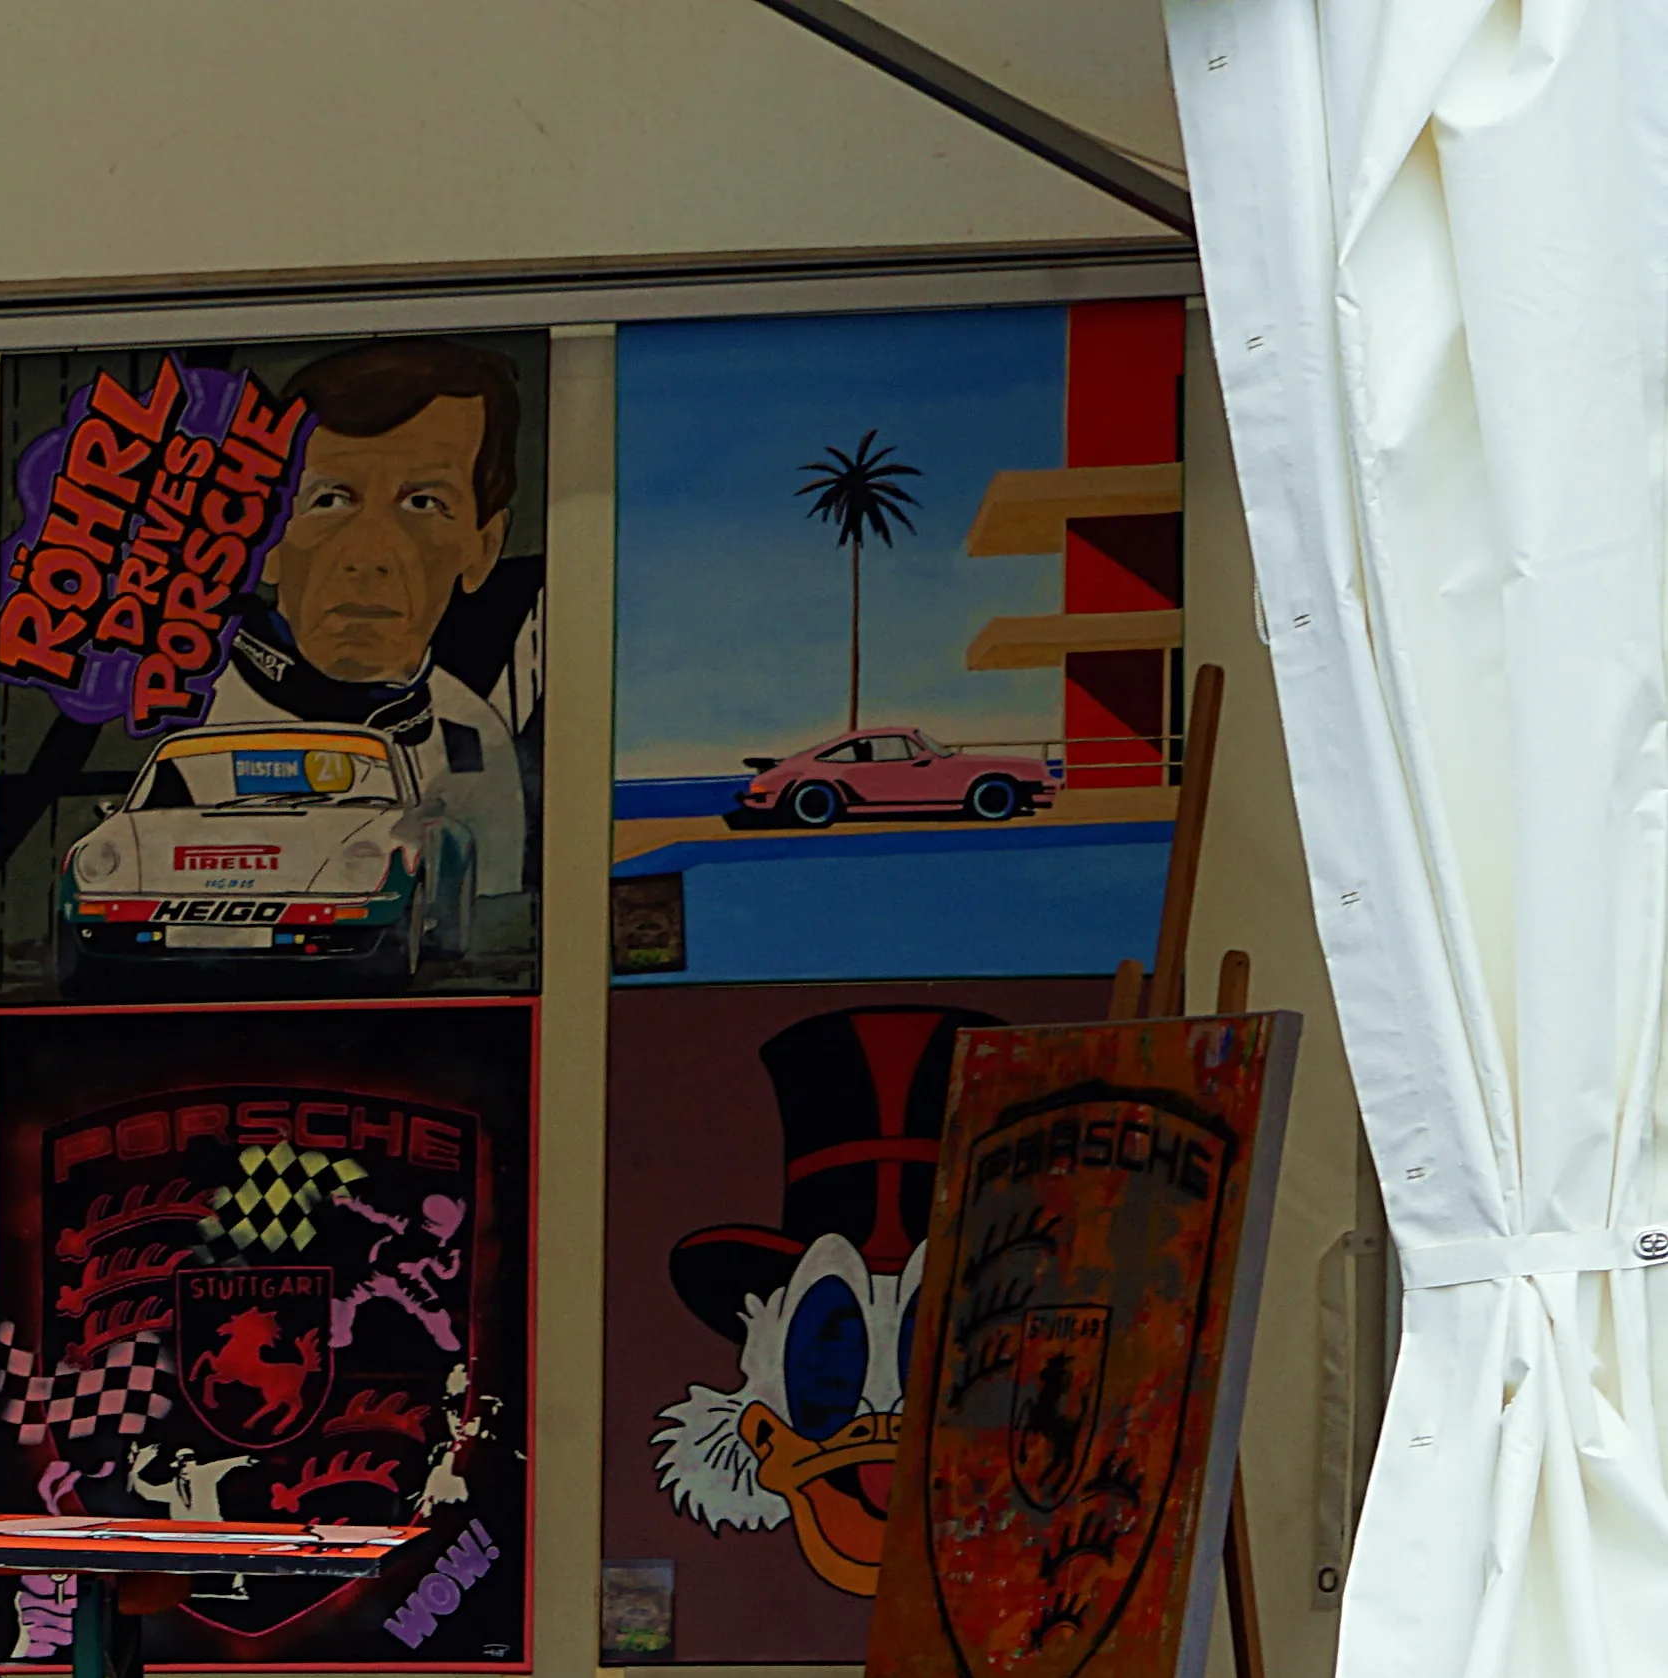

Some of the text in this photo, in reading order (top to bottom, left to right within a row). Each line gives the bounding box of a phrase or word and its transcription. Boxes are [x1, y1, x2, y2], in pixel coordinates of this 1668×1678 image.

[95, 434, 215, 647] DRIVES
[133, 379, 307, 721] PORSCHE
[174, 846, 281, 870] PIRELLI
[153, 902, 287, 922] HEIGO
[55, 1100, 462, 1183] PORSCHE
[974, 1122, 1212, 1204] PORSCHE
[189, 1274, 325, 1301] STUTTGART
[383, 1518, 501, 1650] WOW!
